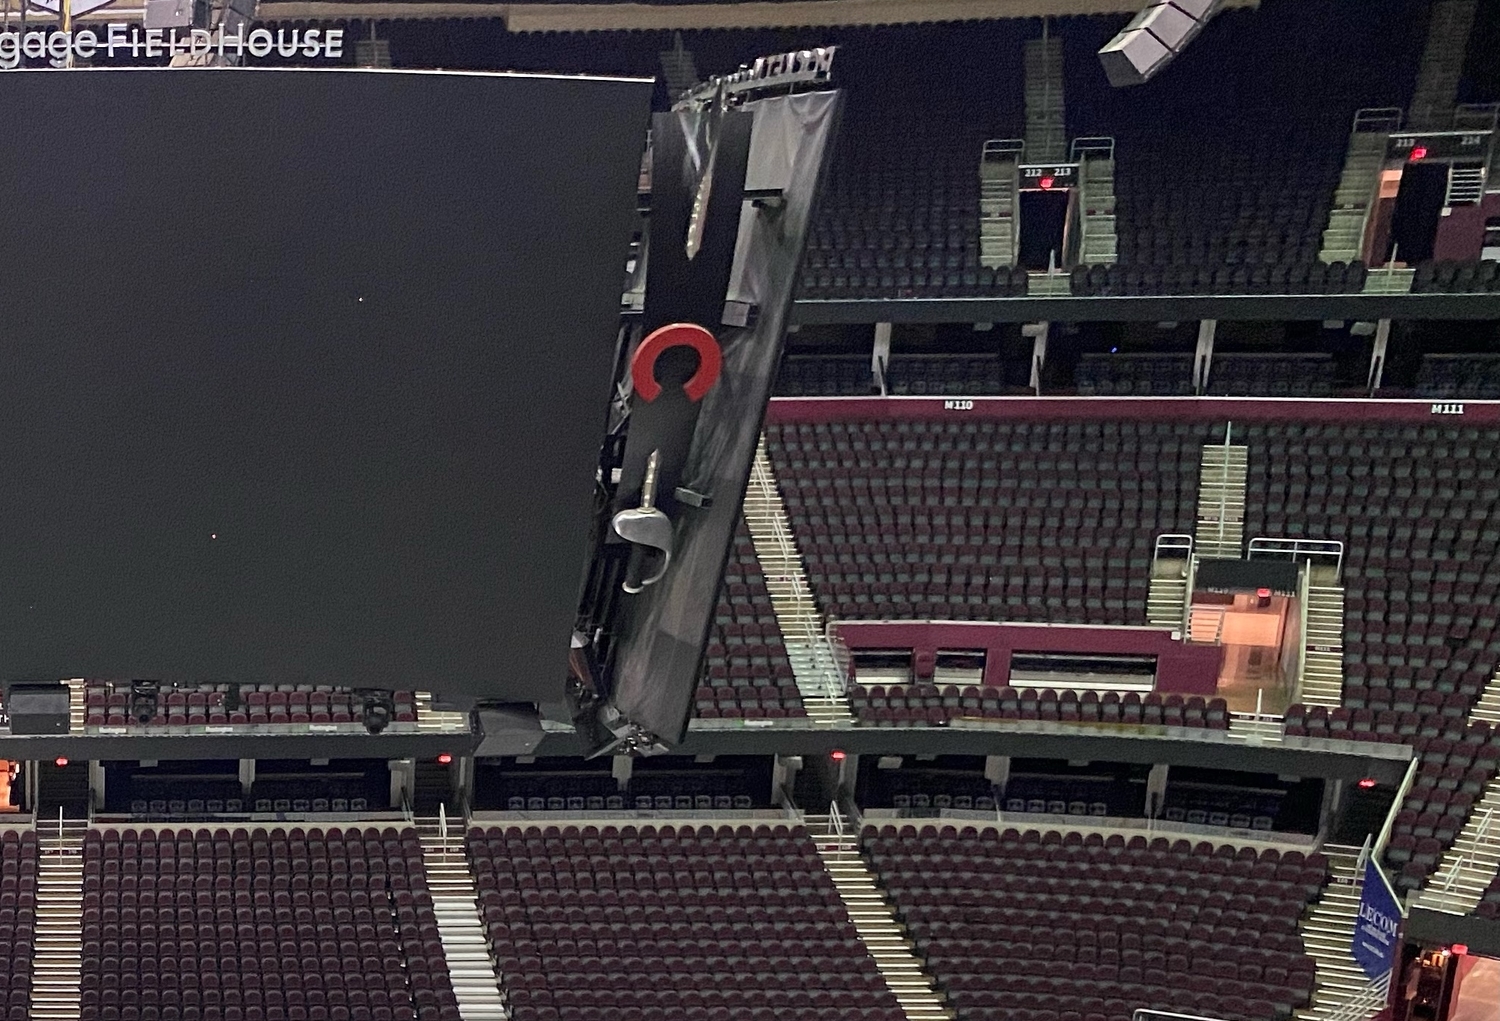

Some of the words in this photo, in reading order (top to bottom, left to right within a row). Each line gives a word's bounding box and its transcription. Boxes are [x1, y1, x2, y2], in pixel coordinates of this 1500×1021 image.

[944, 400, 973, 410] M110
[1431, 404, 1464, 414] M111
[1359, 902, 1398, 937] LECOM
